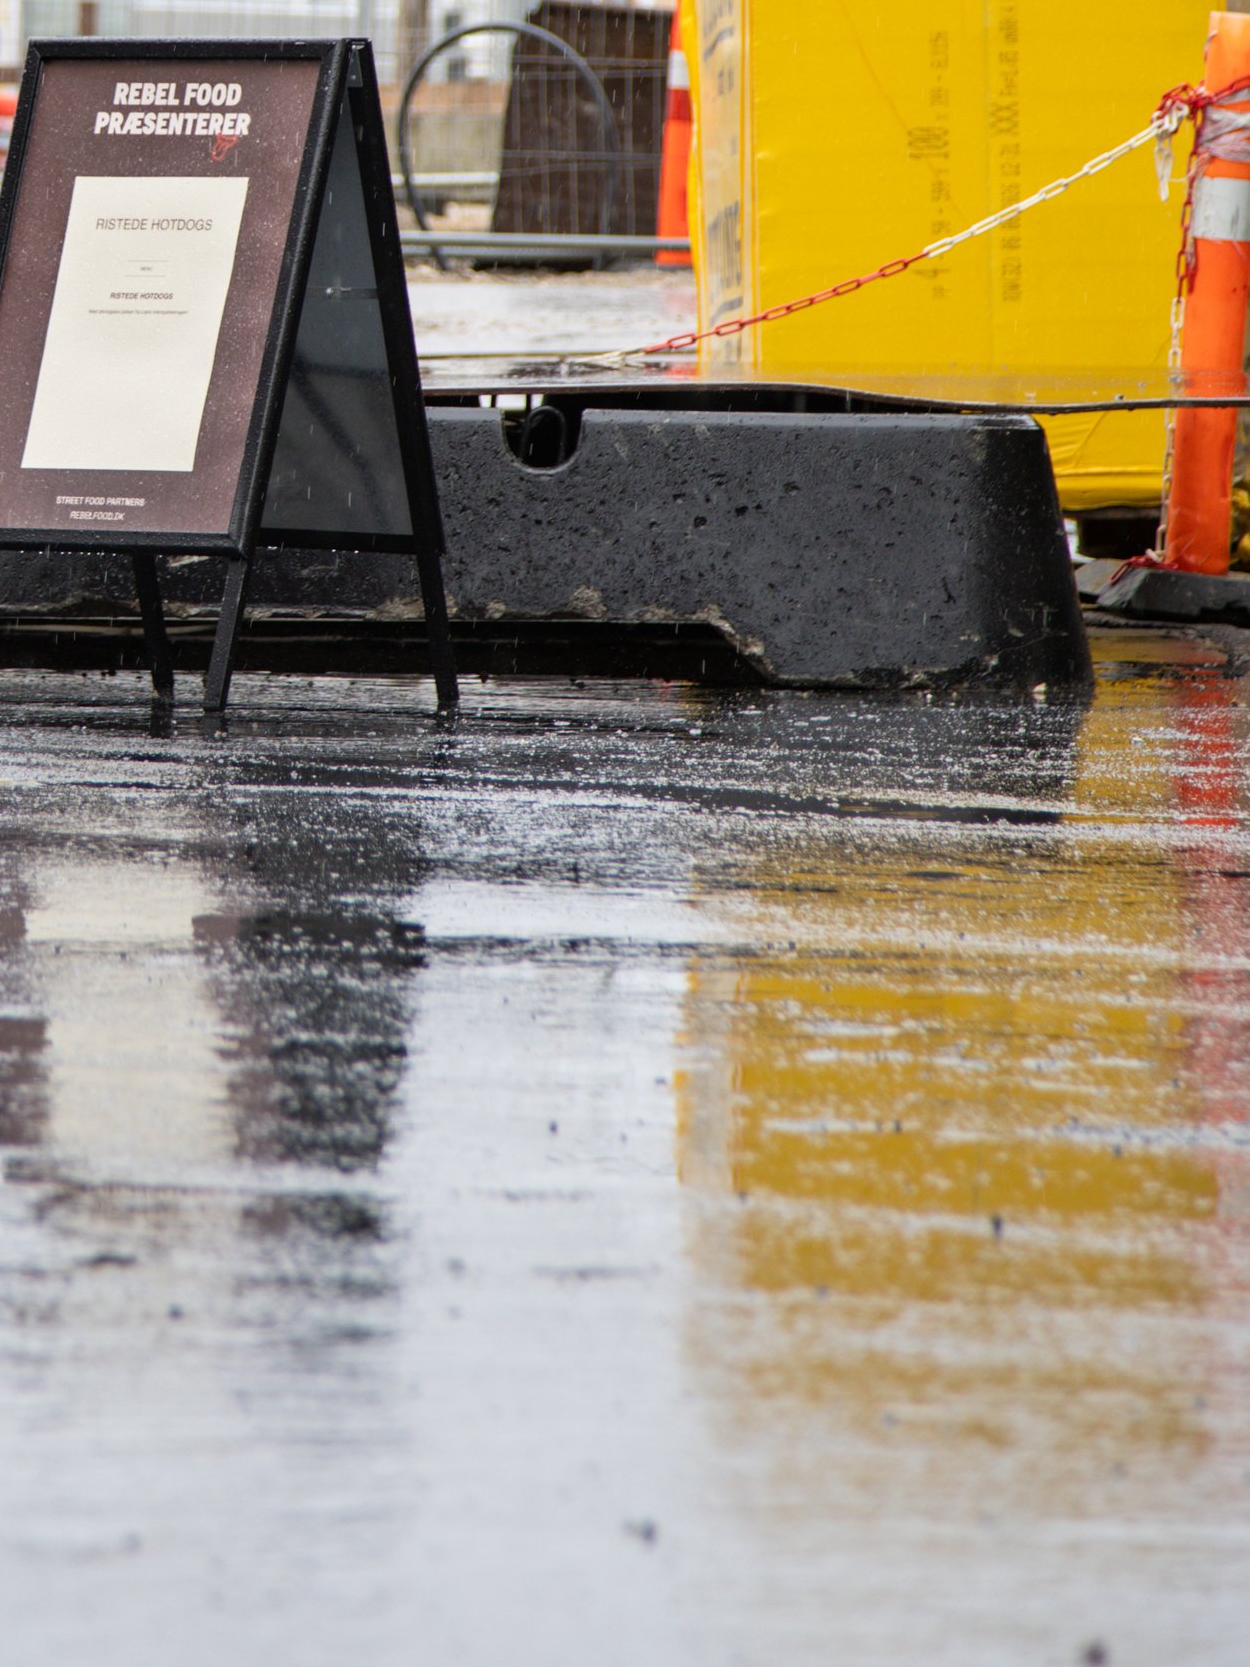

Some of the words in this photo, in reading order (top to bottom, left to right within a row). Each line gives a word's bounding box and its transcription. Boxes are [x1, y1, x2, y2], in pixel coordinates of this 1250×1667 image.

[113, 82, 180, 106] REBEL
[183, 82, 243, 106] FOOD
[93, 111, 252, 136] PRÆSENTERER
[95, 218, 149, 231] RISTEDE
[151, 218, 213, 231] HOTDOGS
[110, 292, 139, 300] RISTEDE
[140, 292, 174, 300] HOTDOGS
[56, 496, 84, 505] STREET
[84, 497, 106, 506] FOOD
[106, 498, 146, 507] PARTNERS
[70, 511, 126, 521] REBELFOOD.DK
